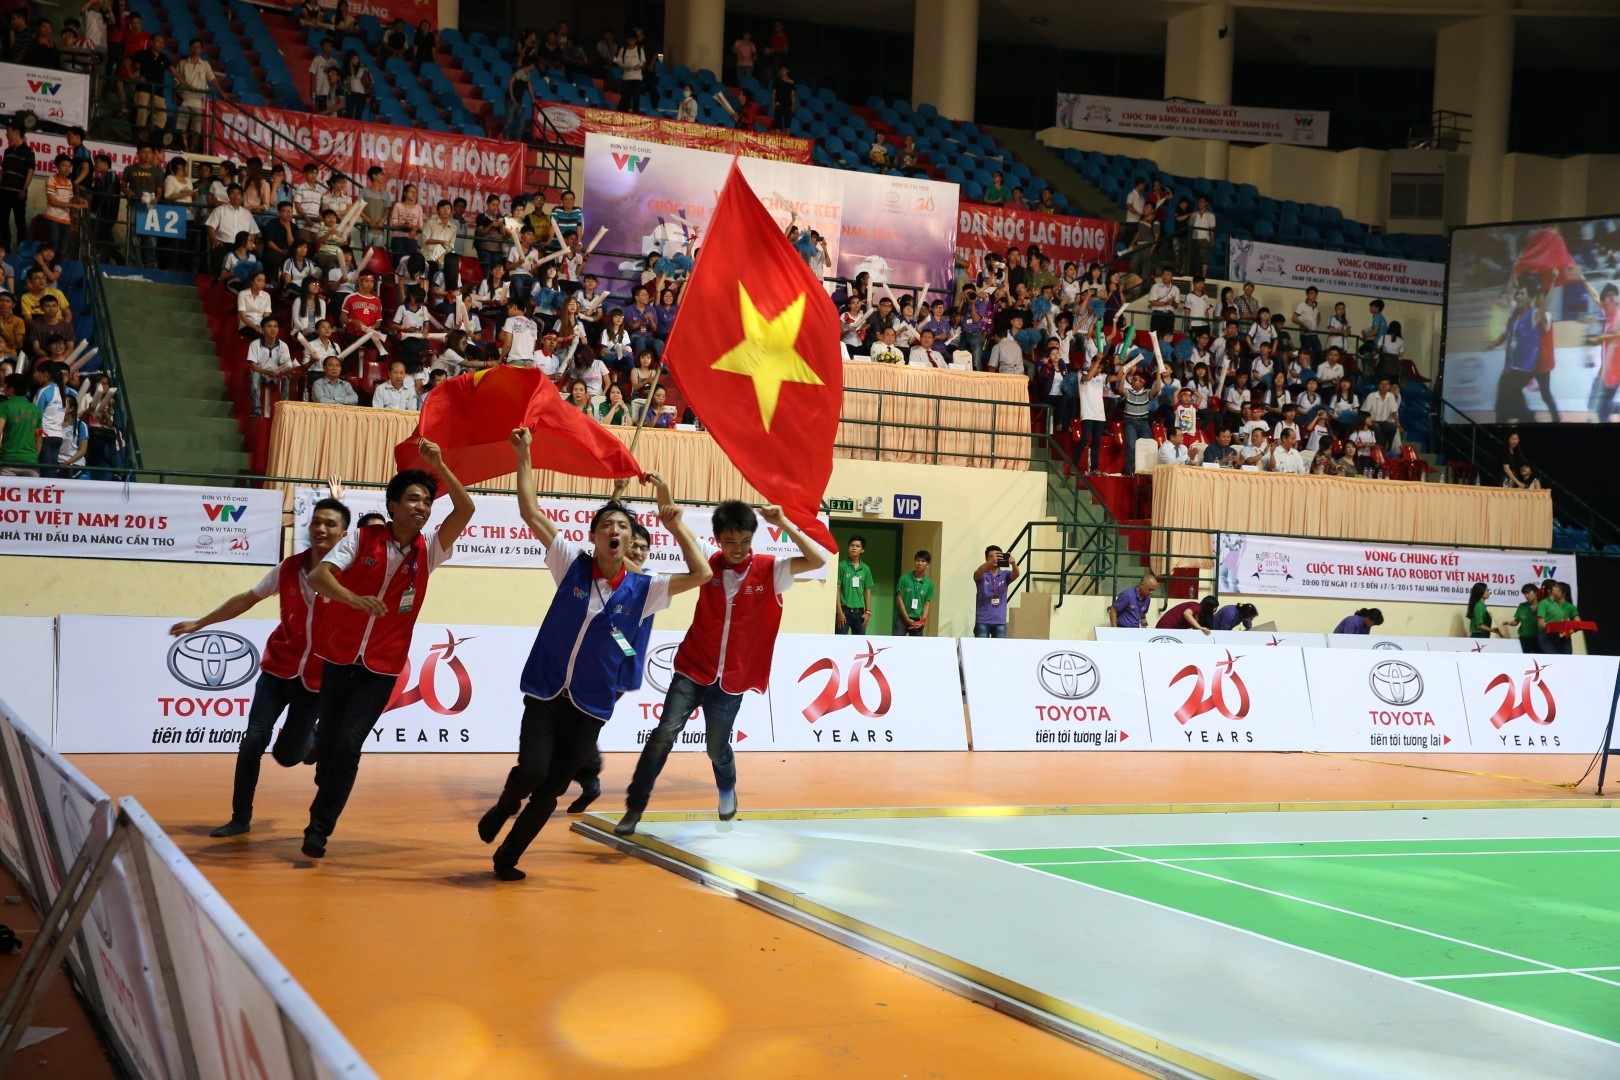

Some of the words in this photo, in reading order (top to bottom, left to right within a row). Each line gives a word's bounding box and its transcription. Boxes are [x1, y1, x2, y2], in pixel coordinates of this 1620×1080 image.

[27, 79, 61, 96] VTV
[1294, 117, 1315, 127] VTV
[318, 129, 354, 162] ĐẠI
[361, 132, 403, 168] HỌC
[409, 139, 445, 174] LẠC
[452, 142, 510, 179] HỒNG
[612, 152, 651, 173] VTV
[960, 210, 989, 241] ĐẠI
[993, 216, 1025, 246] HỌC
[1029, 220, 1056, 249] LẠC
[1061, 219, 1106, 250] HỒNG
[1338, 257, 1361, 268] VÒNG
[1363, 261, 1391, 272] CHUNG
[1392, 262, 1408, 273] KẾT
[1412, 278, 1428, 287] NAM
[28, 484, 65, 504] KẾT
[203, 503, 247, 522] VTV
[831, 500, 852, 509] EXIT
[896, 498, 920, 515] VIP
[35, 508, 73, 528] VIỆT
[77, 513, 119, 527] NAM
[124, 514, 168, 530] 2015
[24, 532, 43, 541] THI
[46, 531, 69, 542] ĐẤU
[72, 534, 87, 543] ĐA
[90, 534, 123, 545] NĂNG
[126, 534, 149, 545] CẦN
[152, 537, 175, 547] THƠ
[481, 525, 505, 539] THI
[510, 524, 538, 540] SÁN
[456, 544, 470, 553] TỪ
[470, 544, 497, 554] NGÀY
[500, 546, 521, 555] 12/5
[523, 545, 541, 555] ĐẾN
[669, 553, 681, 562] ĐA
[1365, 549, 1397, 562] VÒNG
[1400, 552, 1437, 565] CHUNG
[1440, 552, 1460, 566] KẾT
[1306, 562, 1335, 577] CUỘC
[1337, 564, 1354, 576] THI
[1356, 564, 1384, 577] SÁNG
[1386, 567, 1406, 580] TẠO
[1410, 569, 1443, 580] ROBOT
[1445, 569, 1465, 583] VIỆT
[1468, 573, 1489, 583] NAM
[1492, 573, 1515, 584] 2015
[1532, 565, 1557, 579] VTV
[1331, 580, 1348, 588] NGÀY
[1350, 581, 1365, 589] 12/5
[1366, 581, 1378, 589] ĐẾN
[798, 648, 892, 724] 20
[1169, 658, 1250, 725] 20
[158, 697, 250, 717] TOYOT
[1484, 668, 1556, 730] 20
[1035, 705, 1111, 722] TOYOTA
[1369, 711, 1435, 726] TOYOTA
[152, 726, 183, 744] tiến
[184, 726, 206, 744] tới
[372, 728, 470, 742] YEARS
[813, 730, 893, 743] YEARS
[1035, 729, 1055, 743] tiến
[1057, 729, 1071, 743] tới
[1073, 731, 1102, 746] tương
[1104, 730, 1117, 743] lai
[1184, 731, 1254, 743] YEARS
[1370, 733, 1388, 746] tiến
[1390, 733, 1401, 746] tới
[1403, 734, 1428, 749] tương
[1430, 734, 1441, 746] lai
[1500, 735, 1561, 747] YEARS
